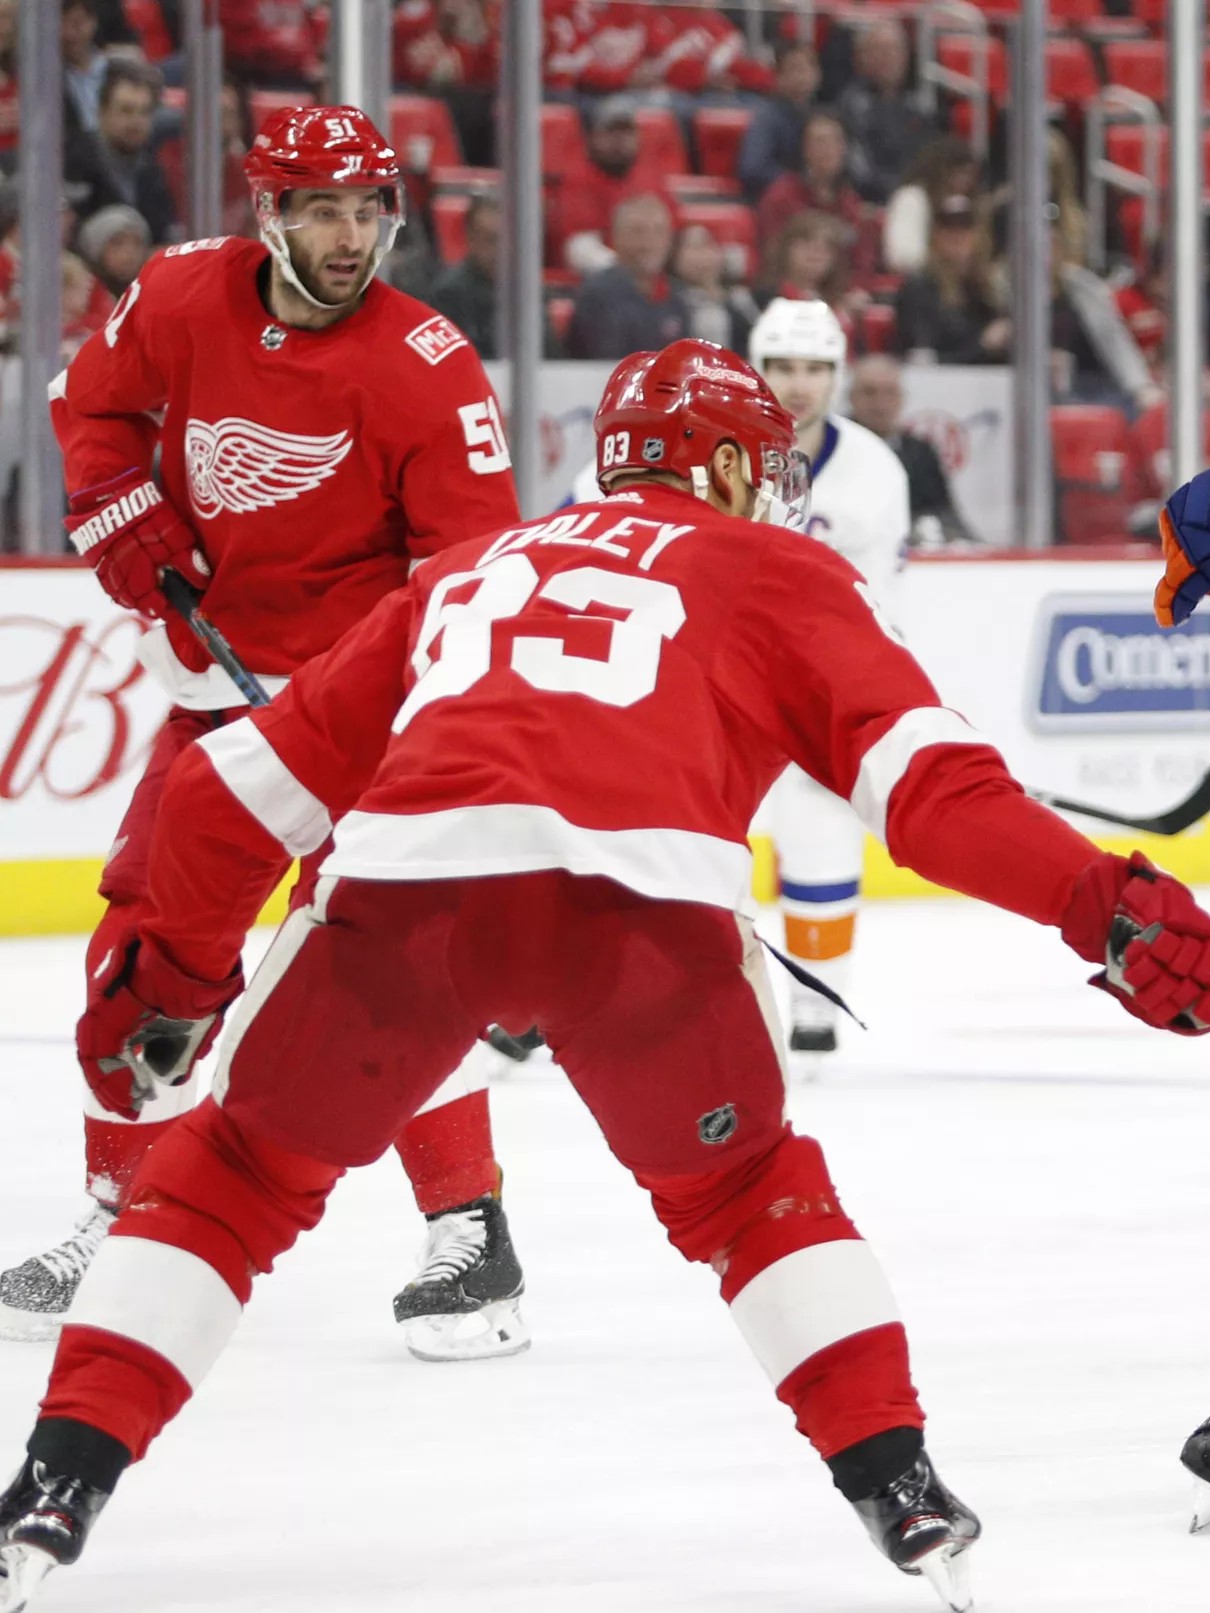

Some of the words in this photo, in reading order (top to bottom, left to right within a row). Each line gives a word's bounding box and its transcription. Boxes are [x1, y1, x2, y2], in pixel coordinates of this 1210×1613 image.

[324, 118, 357, 137] 51
[457, 395, 513, 475] 51
[602, 430, 631, 468] 83
[475, 511, 696, 571] DALEY
[391, 552, 688, 735] 83
